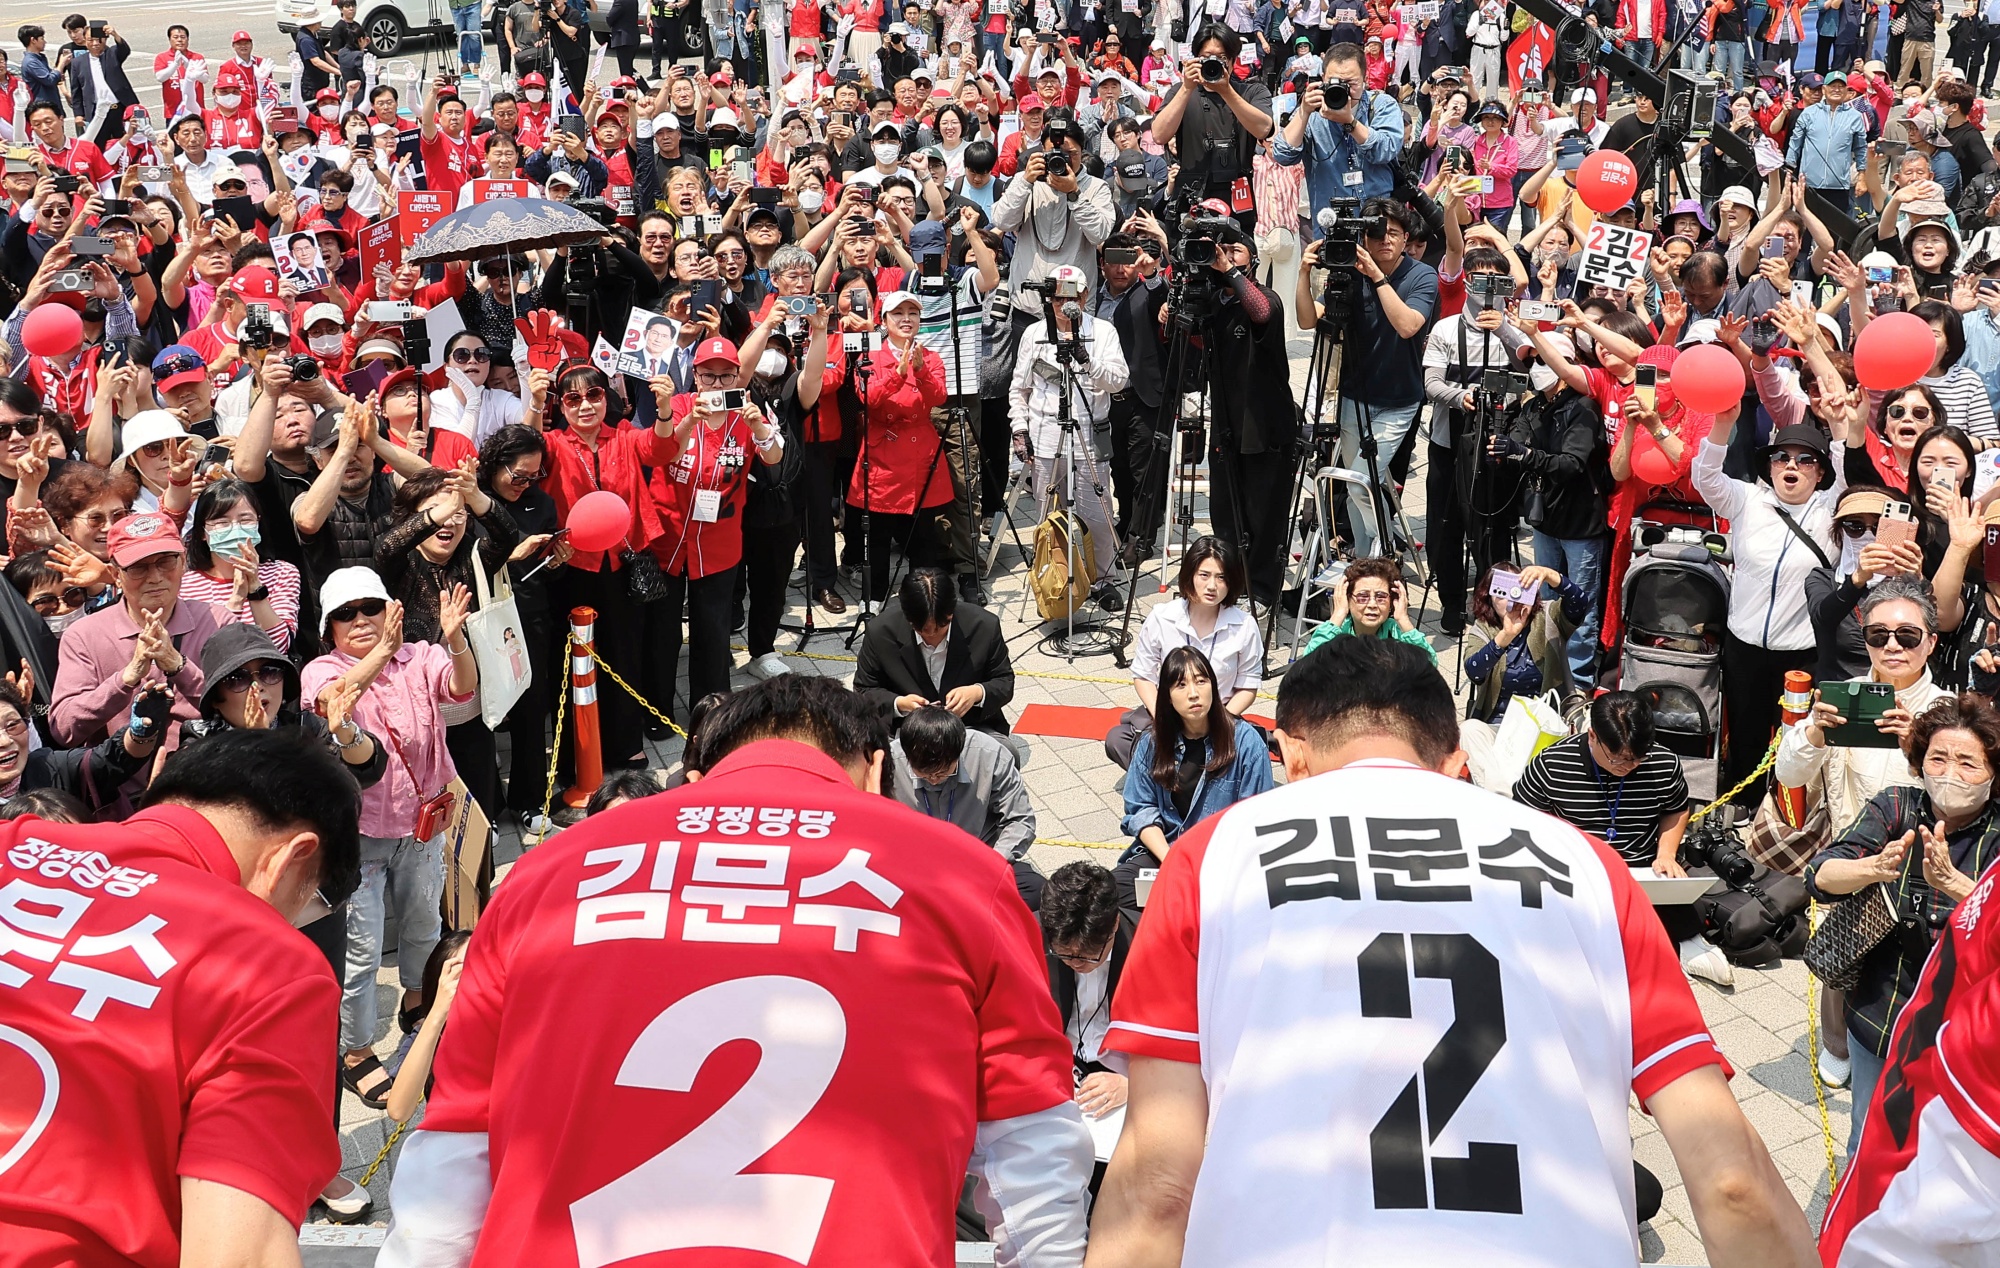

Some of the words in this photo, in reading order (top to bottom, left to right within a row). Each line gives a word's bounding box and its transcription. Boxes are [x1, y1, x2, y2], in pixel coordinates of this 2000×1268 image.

[915, 36, 920, 44] 2
[235, 118, 254, 138] 2
[1603, 161, 1631, 175] 대통령
[489, 182, 513, 191] 새롭게
[1600, 171, 1629, 186] 김문수
[409, 203, 442, 213] 대한민국
[413, 194, 437, 203] 새롭게
[371, 222, 390, 237] 새롭게
[421, 218, 429, 228] 2
[368, 230, 393, 247] 대한민국
[1588, 225, 1605, 251] 2
[1607, 228, 1634, 259] 김
[1630, 235, 1648, 260] 2
[379, 248, 385, 258] 2
[277, 255, 292, 274] 2
[264, 279, 273, 293] 2
[624, 328, 641, 350] 2
[712, 341, 723, 353] 2
[617, 358, 654, 377] 김문수
[719, 446, 744, 455] 구의원
[675, 805, 837, 840] 정정당당
[7, 836, 159, 898] 정정당당
[1254, 814, 1573, 910] 김문수
[573, 840, 905, 953] 김문수
[0, 877, 179, 1023] 문수
[1356, 931, 1525, 1216] 2
[568, 974, 848, 1268] 2
